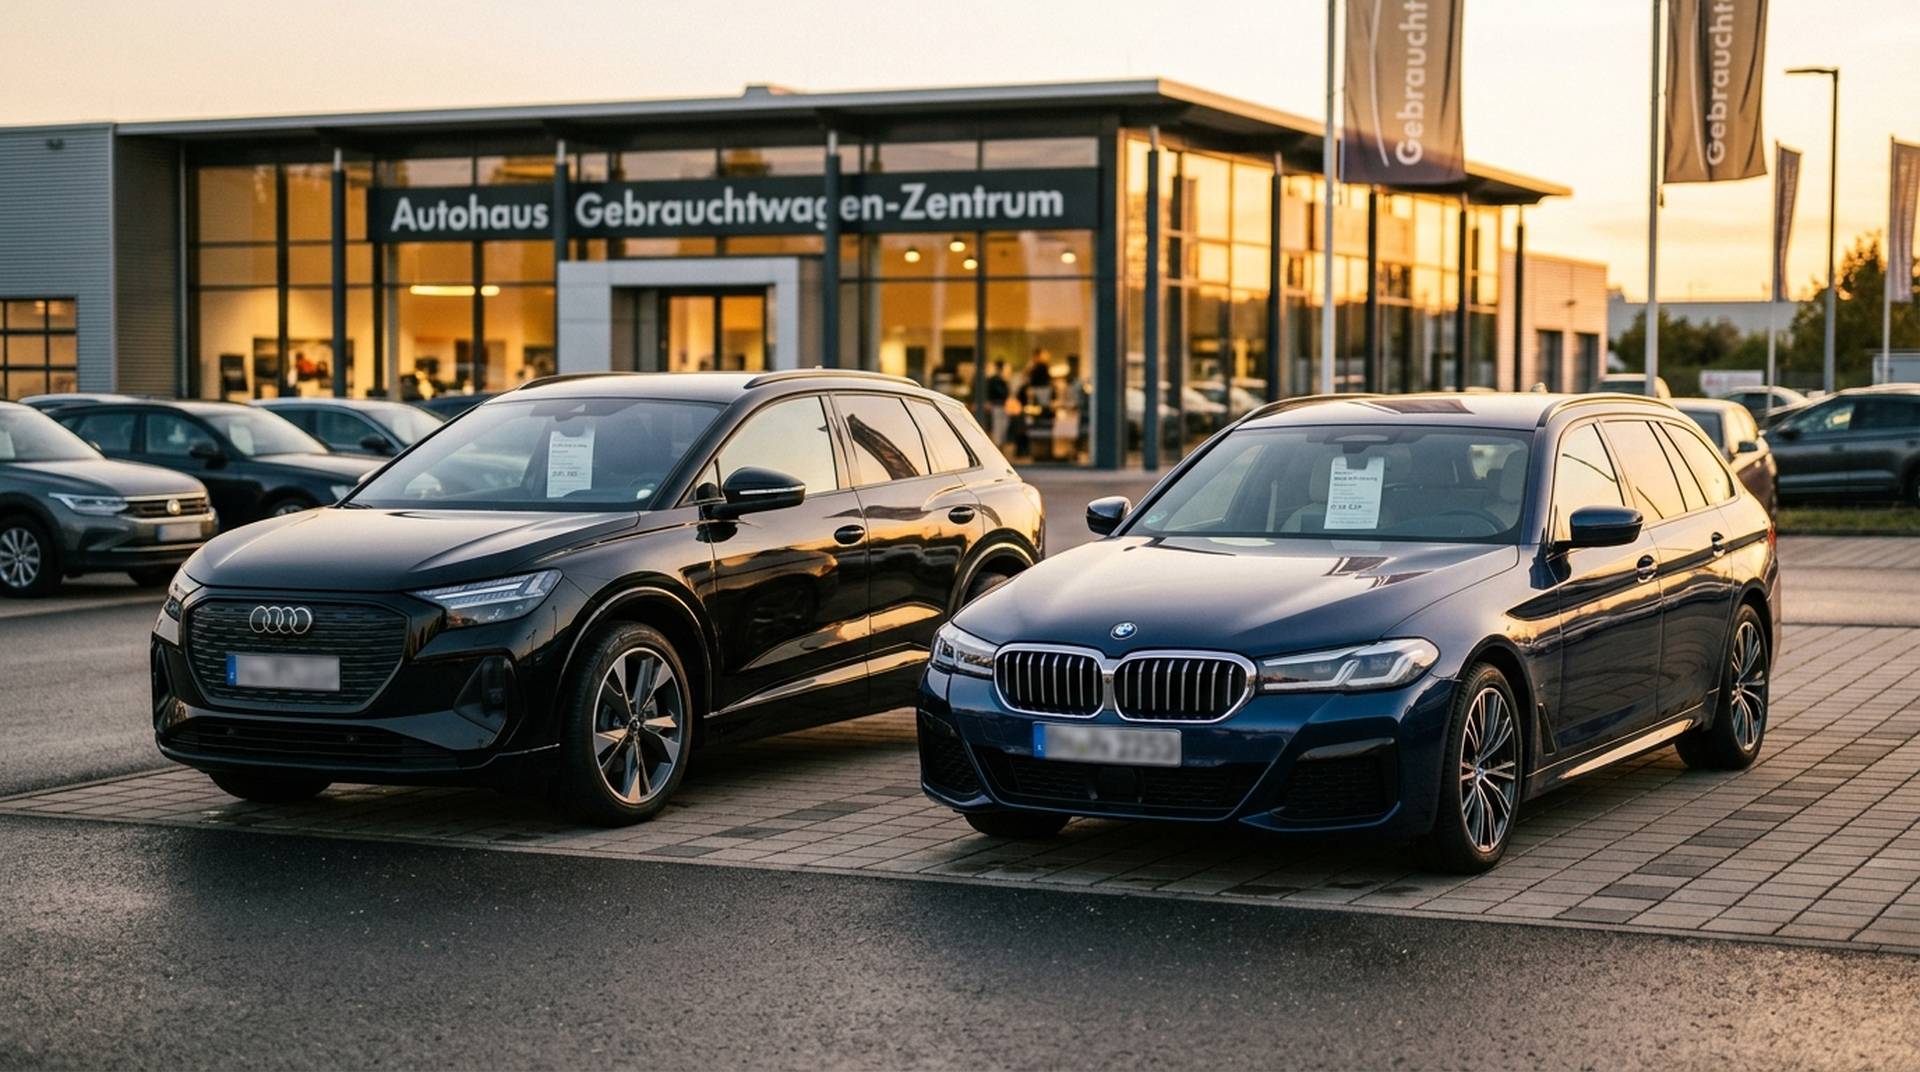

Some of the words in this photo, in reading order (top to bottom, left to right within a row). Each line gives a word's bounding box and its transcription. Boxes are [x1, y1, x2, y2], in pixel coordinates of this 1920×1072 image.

[1395, 0, 1428, 165] Gebraucht
[1706, 0, 1734, 166] Gebraucht
[391, 193, 549, 232] Autohaus
